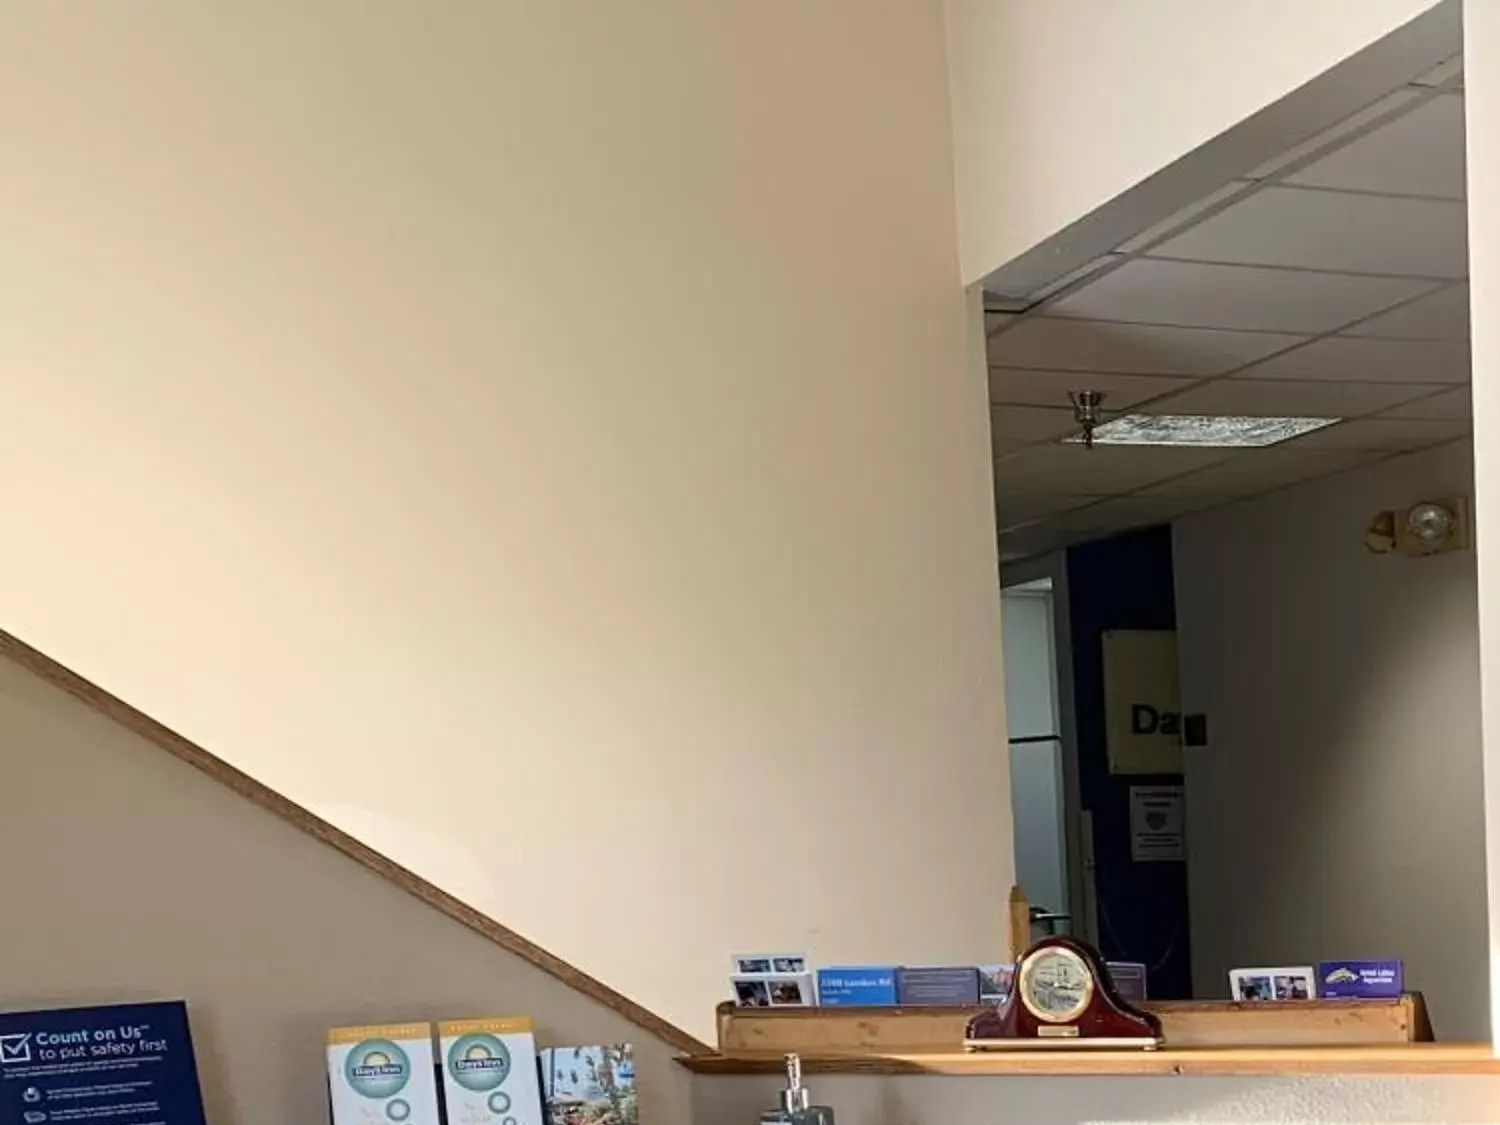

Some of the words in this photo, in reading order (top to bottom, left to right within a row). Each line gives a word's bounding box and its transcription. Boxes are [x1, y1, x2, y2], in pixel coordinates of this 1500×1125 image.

[1132, 704, 1182, 737] Da
[36, 1029, 89, 1045] Count
[94, 1029, 116, 1041] on
[120, 1026, 141, 1039] Us
[40, 1049, 57, 1061] to
[60, 1045, 87, 1060] put
[90, 1041, 136, 1056] safety
[140, 1039, 169, 1052] first
